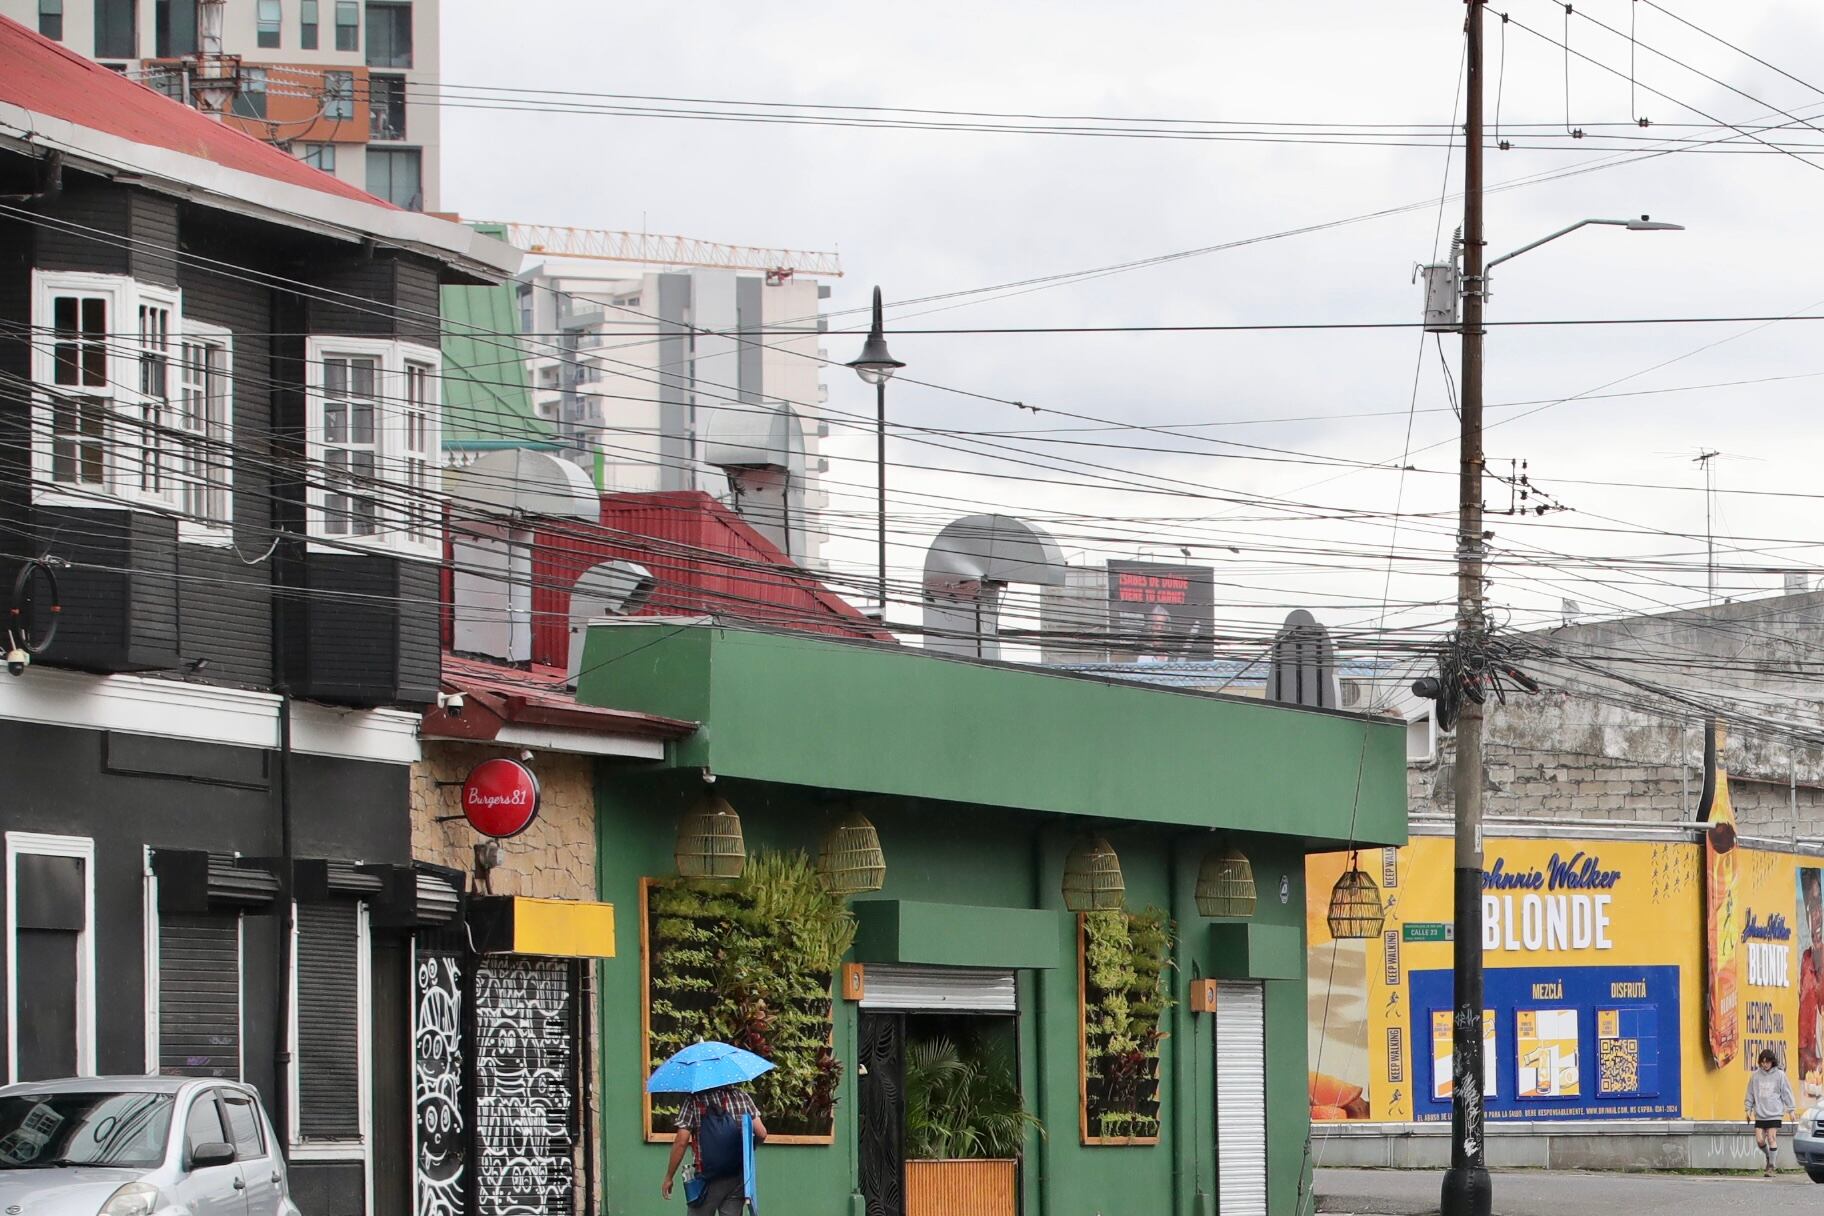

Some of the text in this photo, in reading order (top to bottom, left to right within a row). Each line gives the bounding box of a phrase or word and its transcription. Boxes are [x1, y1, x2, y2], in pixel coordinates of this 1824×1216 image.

[1385, 868, 1394, 886] KEEP
[1482, 852, 1621, 891] ohnnie Walker
[1482, 893, 1613, 951] BLONDE
[1386, 932, 1397, 983] KEEP WALKING
[1747, 943, 1790, 988] BLONDE
[1532, 978, 1564, 999] MEZCLÁ
[1611, 978, 1647, 998] DISFRUTÁ
[1746, 1002, 1773, 1034] HECHOS
[1388, 1029, 1400, 1080] KEEP WALKING
[1501, 1110, 1509, 1118] LA
